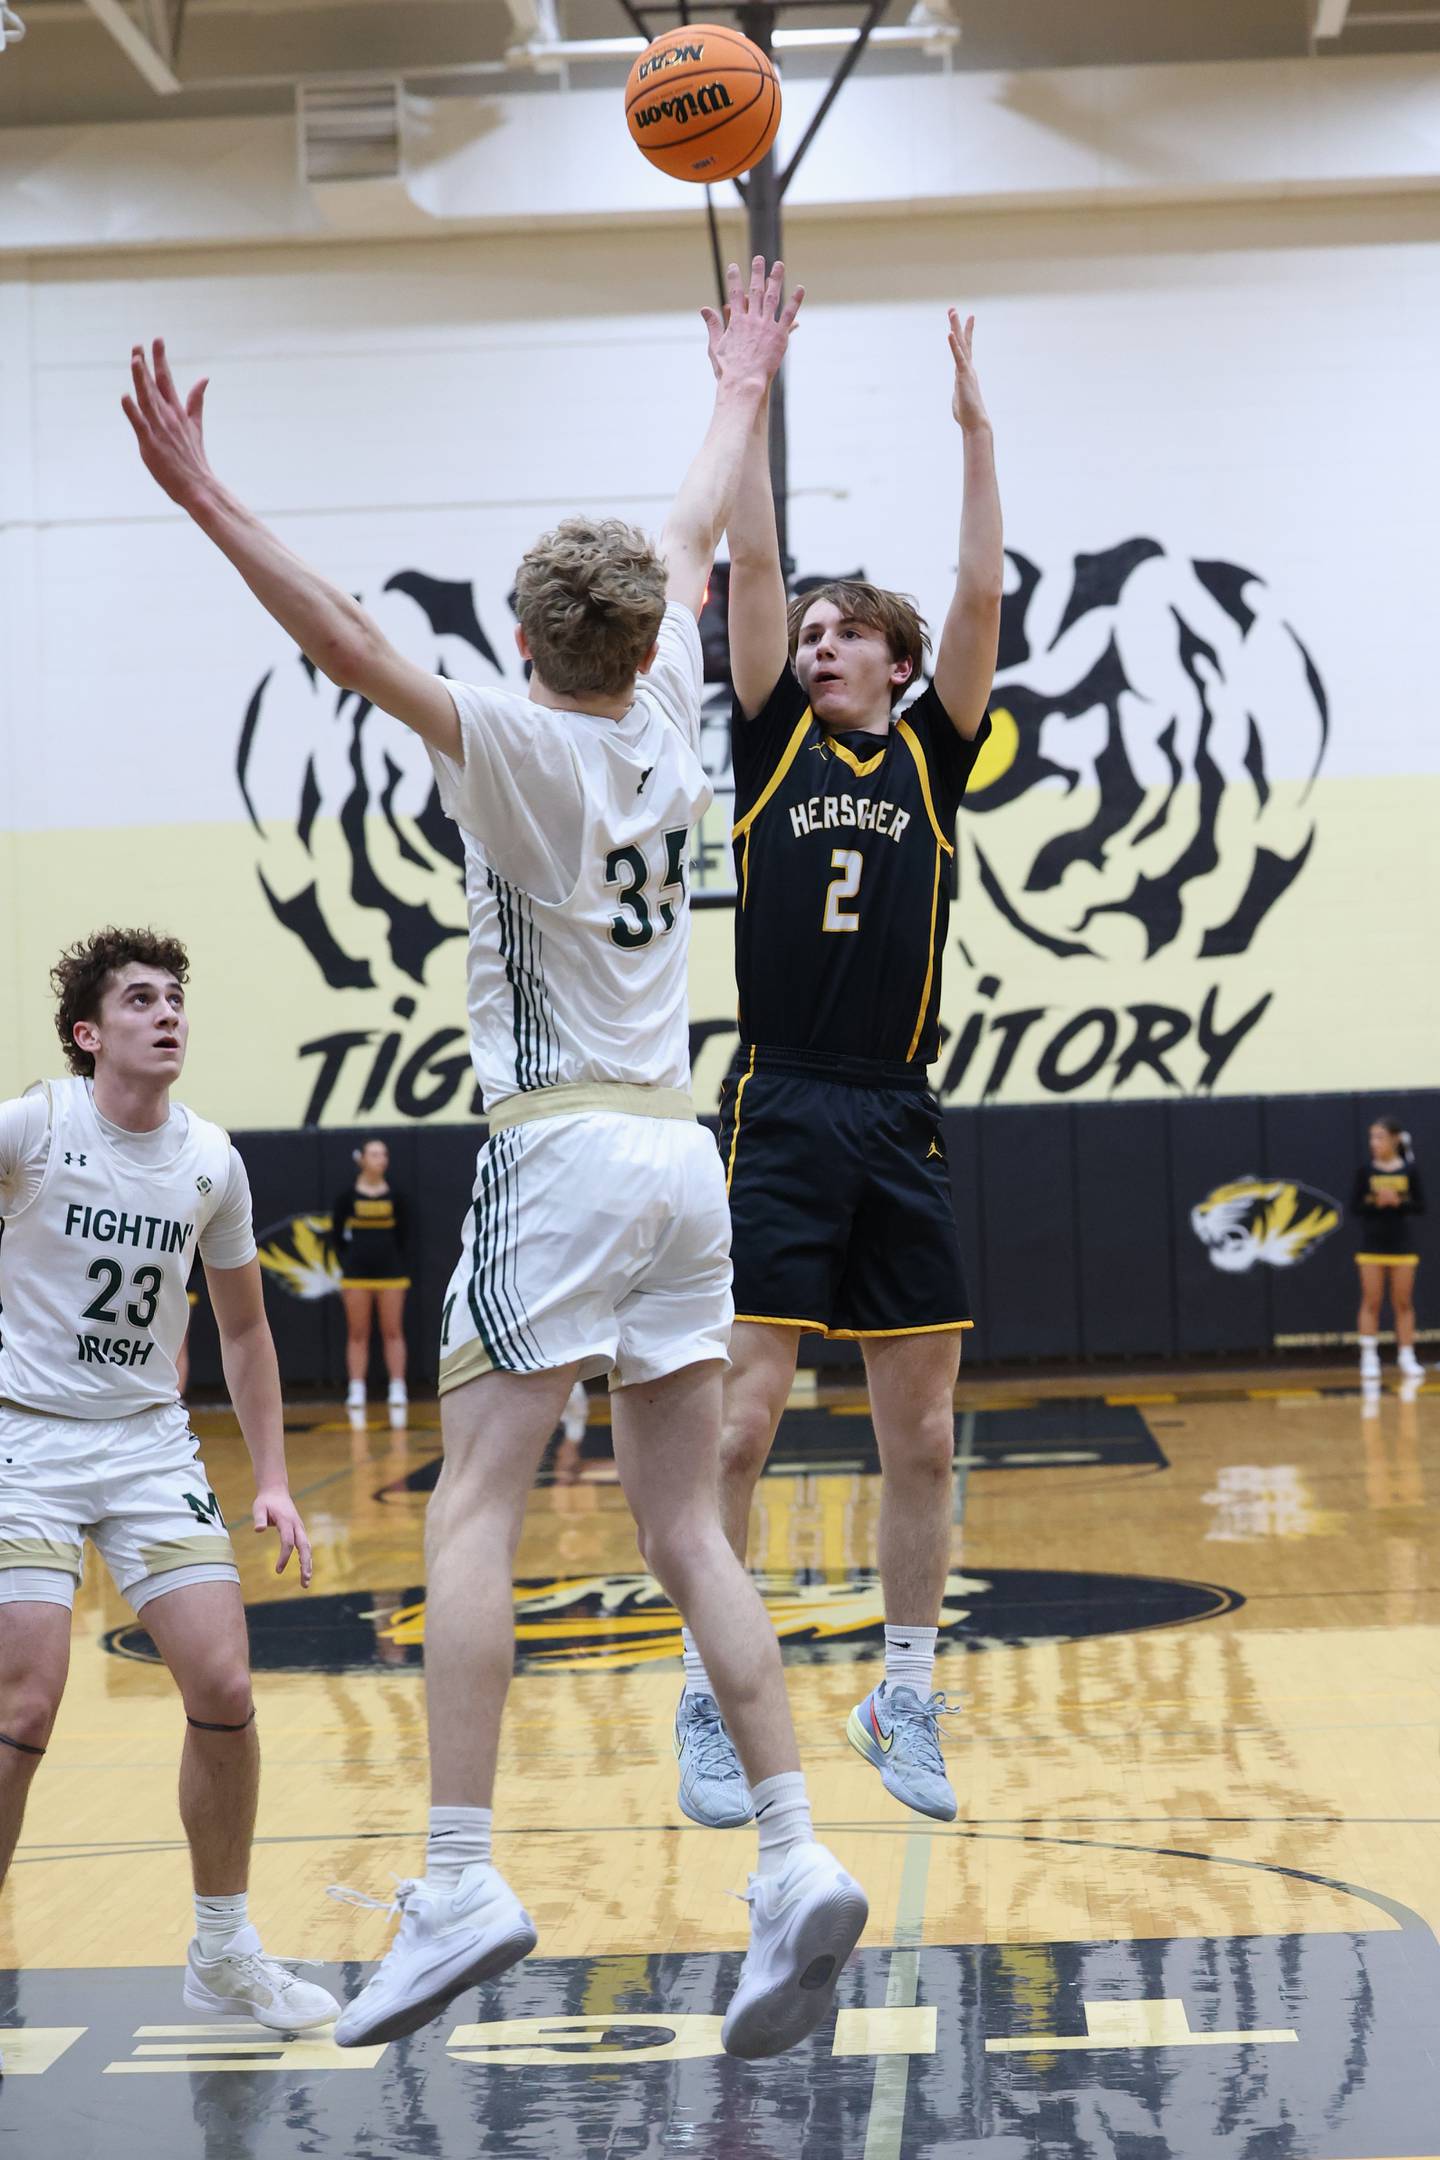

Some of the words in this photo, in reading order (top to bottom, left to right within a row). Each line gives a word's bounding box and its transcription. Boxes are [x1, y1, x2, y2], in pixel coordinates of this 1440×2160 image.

[637, 44, 704, 82] NCAA
[635, 80, 734, 128] Wilson
[604, 824, 690, 950] 35
[822, 848, 864, 932] 2
[65, 1204, 193, 1253] FIGHTIN'
[79, 1256, 164, 1329] 23
[76, 1334, 154, 1366] IRISH
